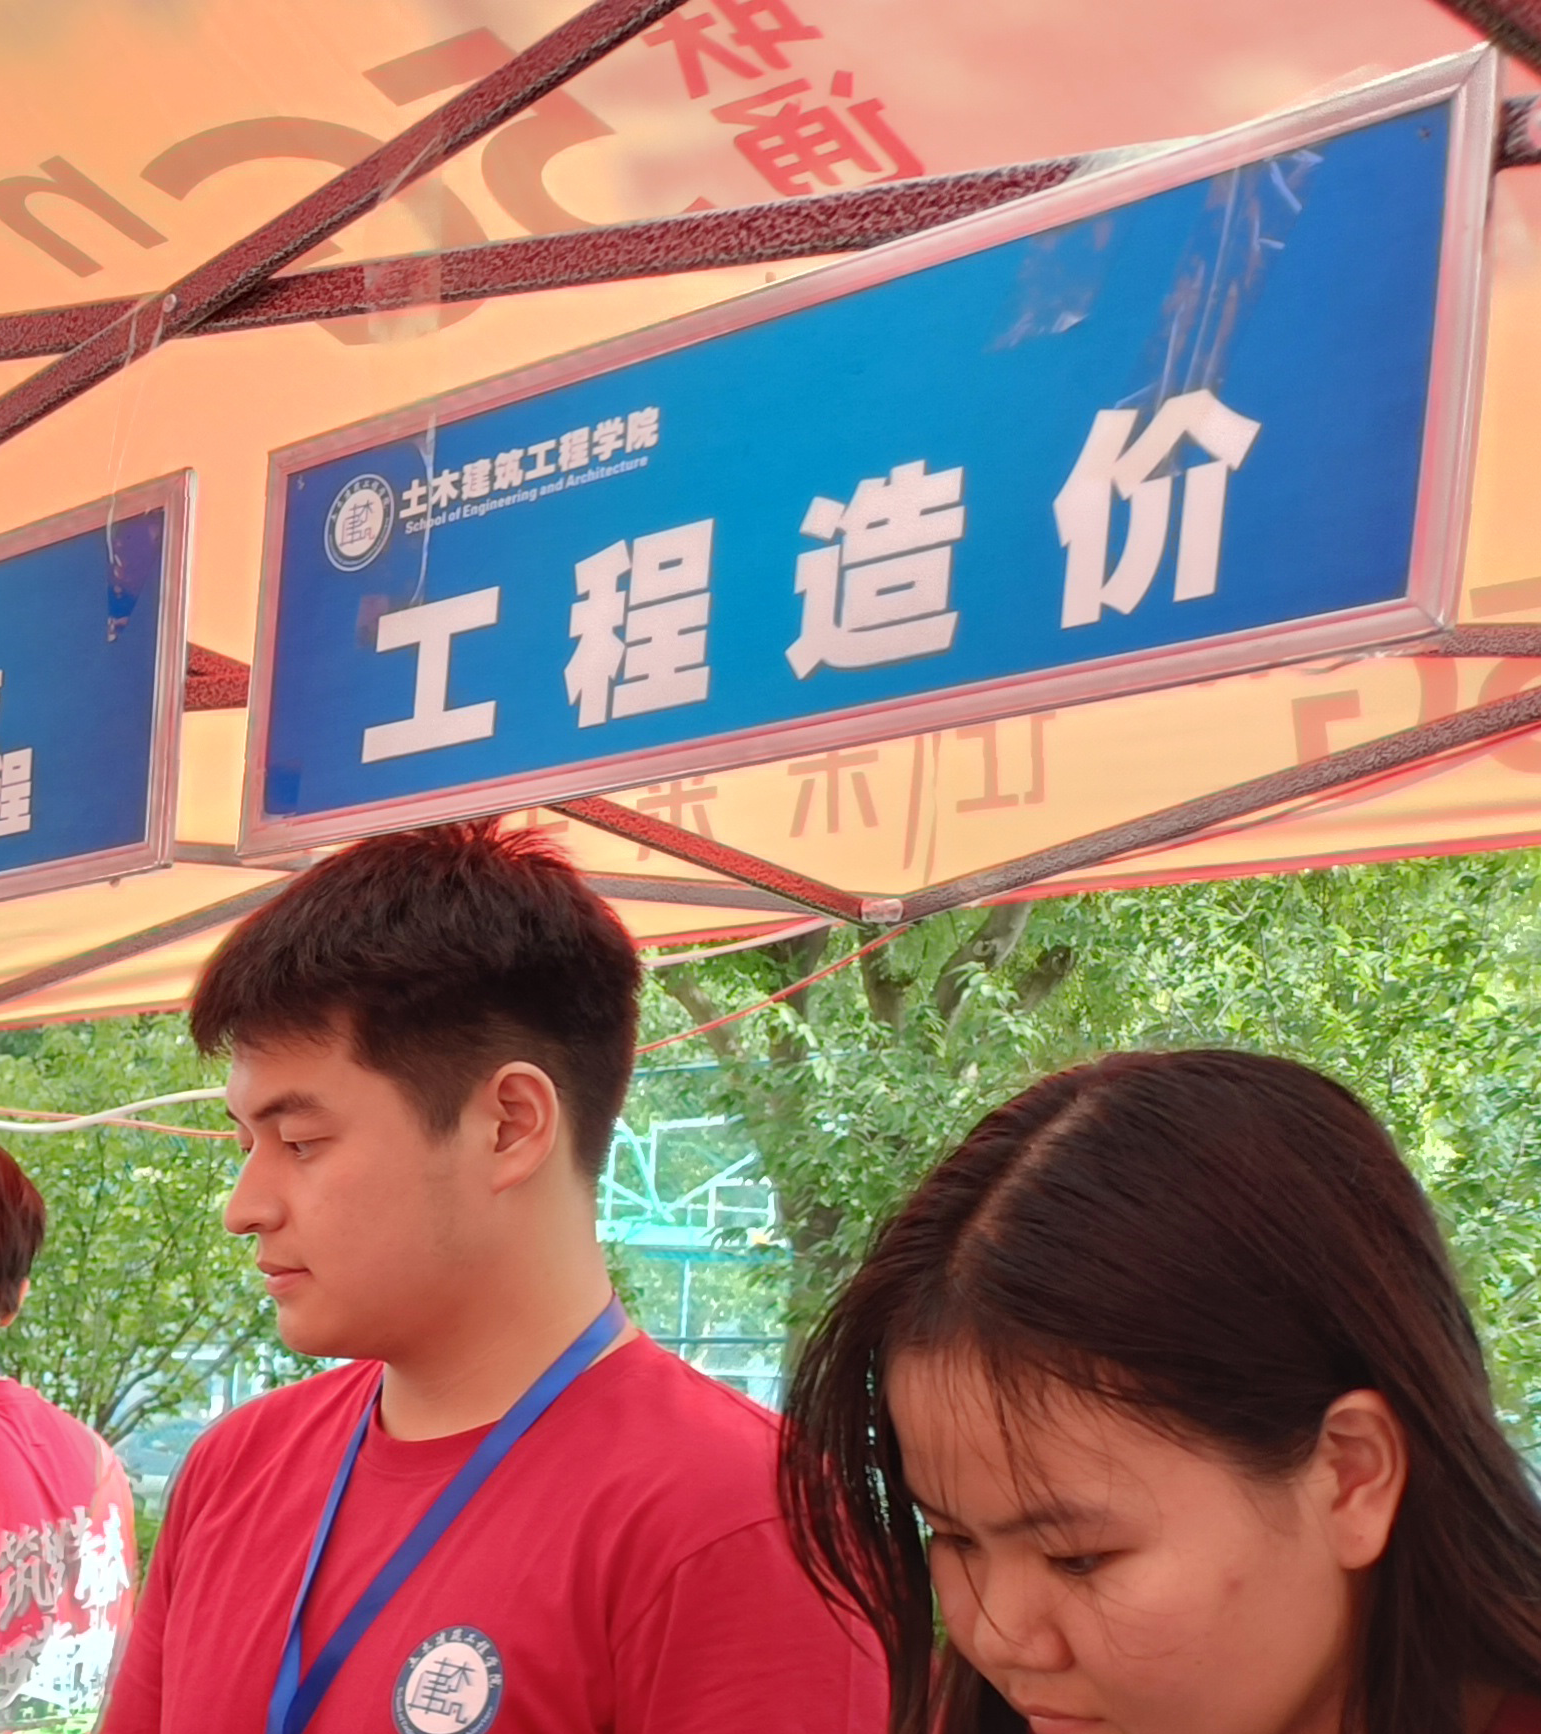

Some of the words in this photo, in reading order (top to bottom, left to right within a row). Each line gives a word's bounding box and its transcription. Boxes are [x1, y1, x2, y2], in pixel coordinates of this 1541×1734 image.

[399, 406, 659, 519] 土木建筑工程学院
[405, 512, 446, 535] School
[448, 508, 461, 522] of
[462, 485, 538, 519] Engineering
[540, 478, 564, 495] and
[565, 455, 649, 488] Architecture
[361, 389, 1261, 764] 工程造价
